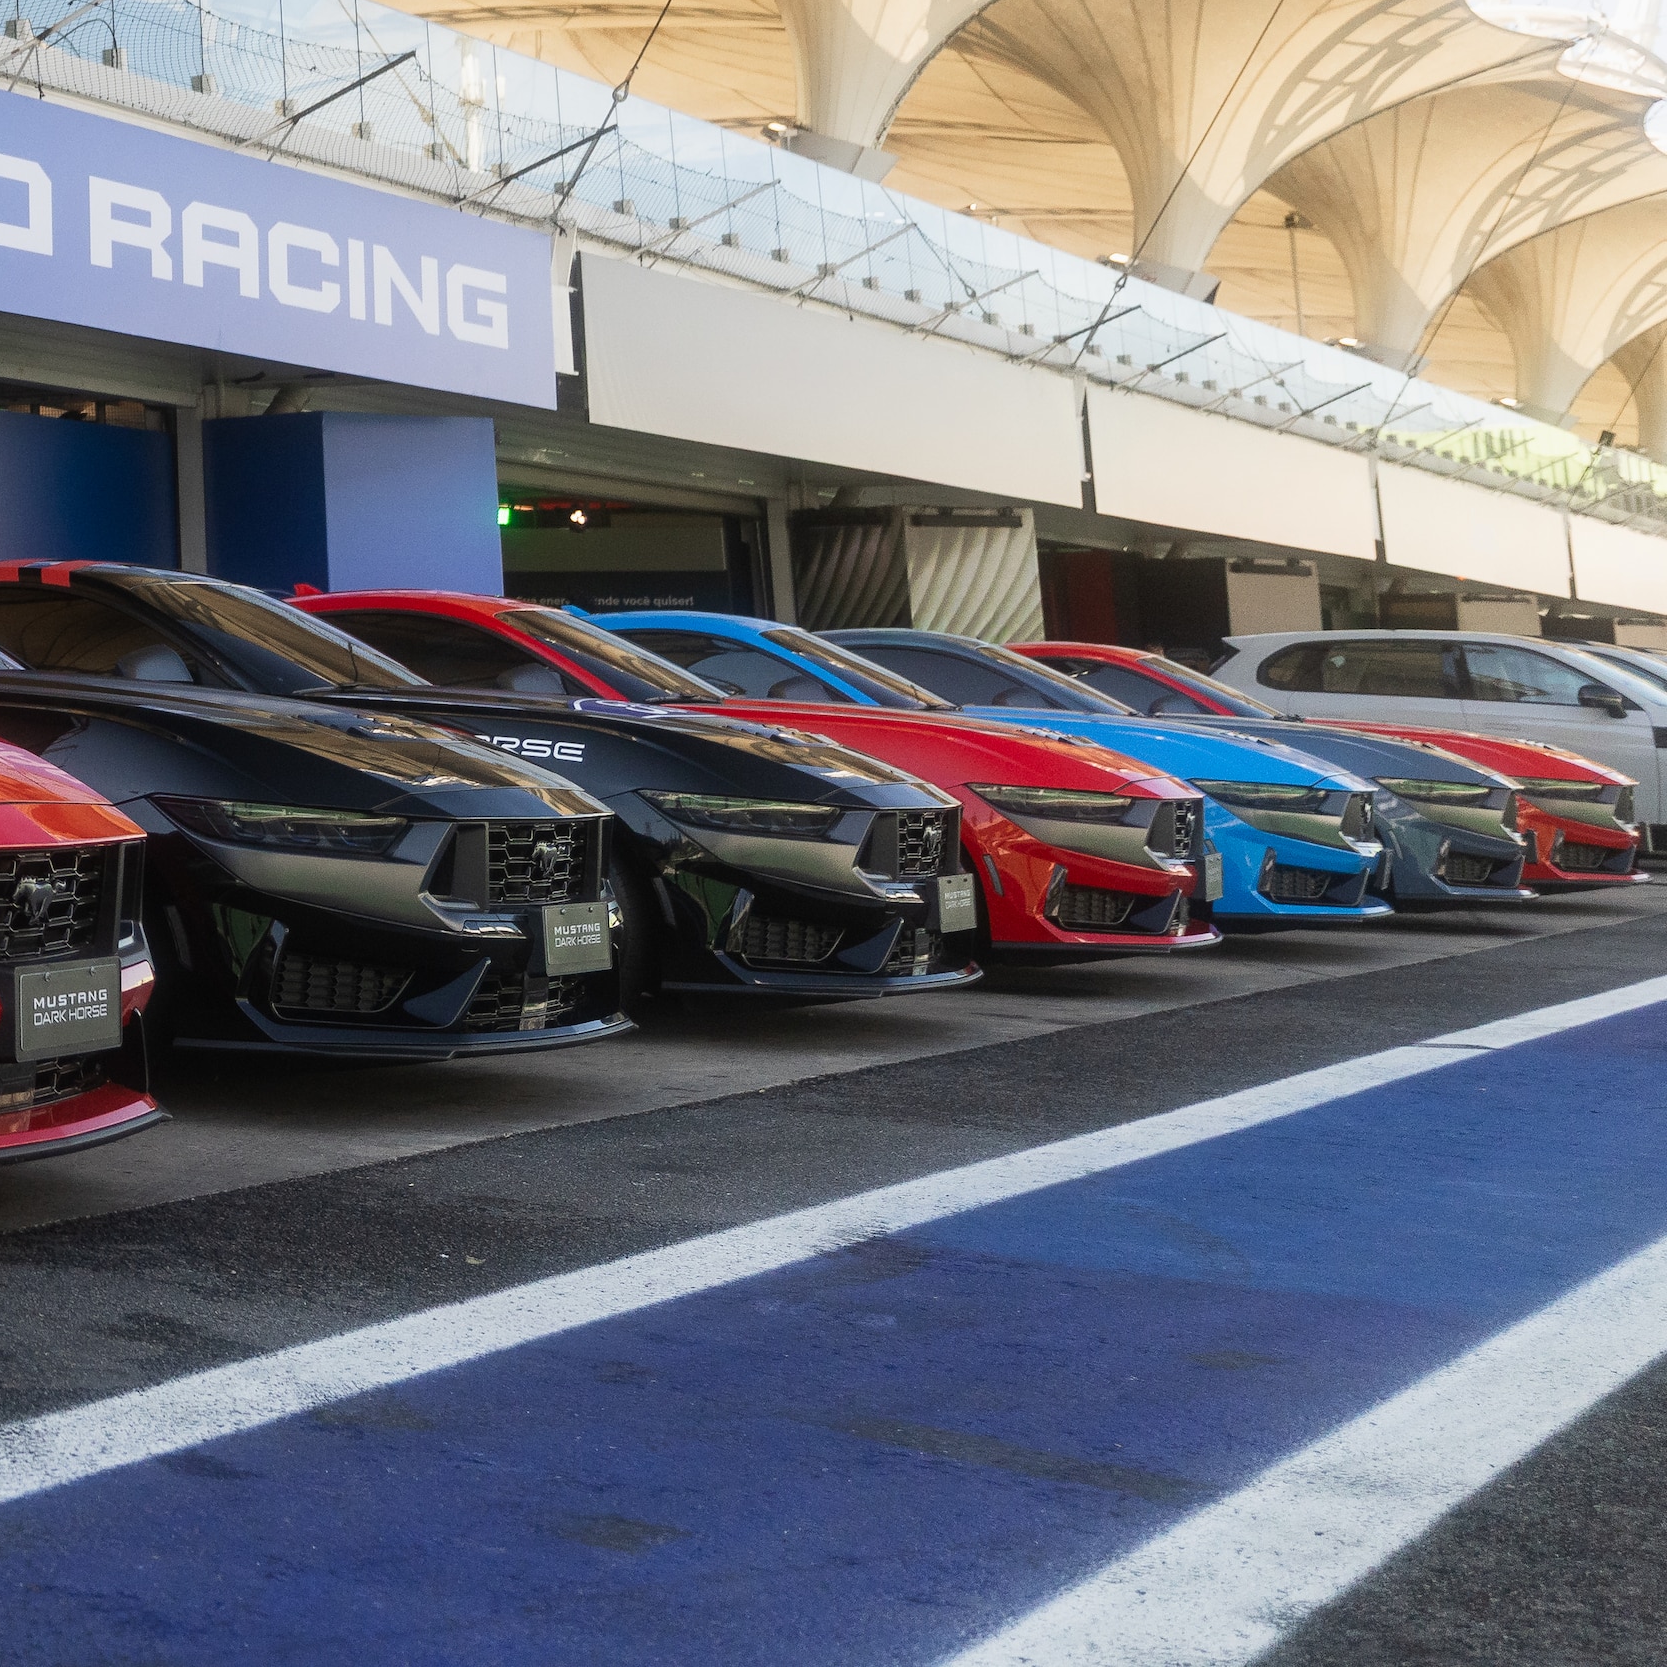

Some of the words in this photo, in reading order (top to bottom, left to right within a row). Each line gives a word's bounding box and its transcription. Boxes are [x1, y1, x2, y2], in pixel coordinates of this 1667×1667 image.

[89, 174, 508, 349] RACING
[474, 735, 585, 762] RSE
[554, 923, 600, 935] MUSTANG
[33, 989, 107, 1009] MUSTANG
[34, 1010, 67, 1026] DARK
[69, 1004, 107, 1022] HORSE
